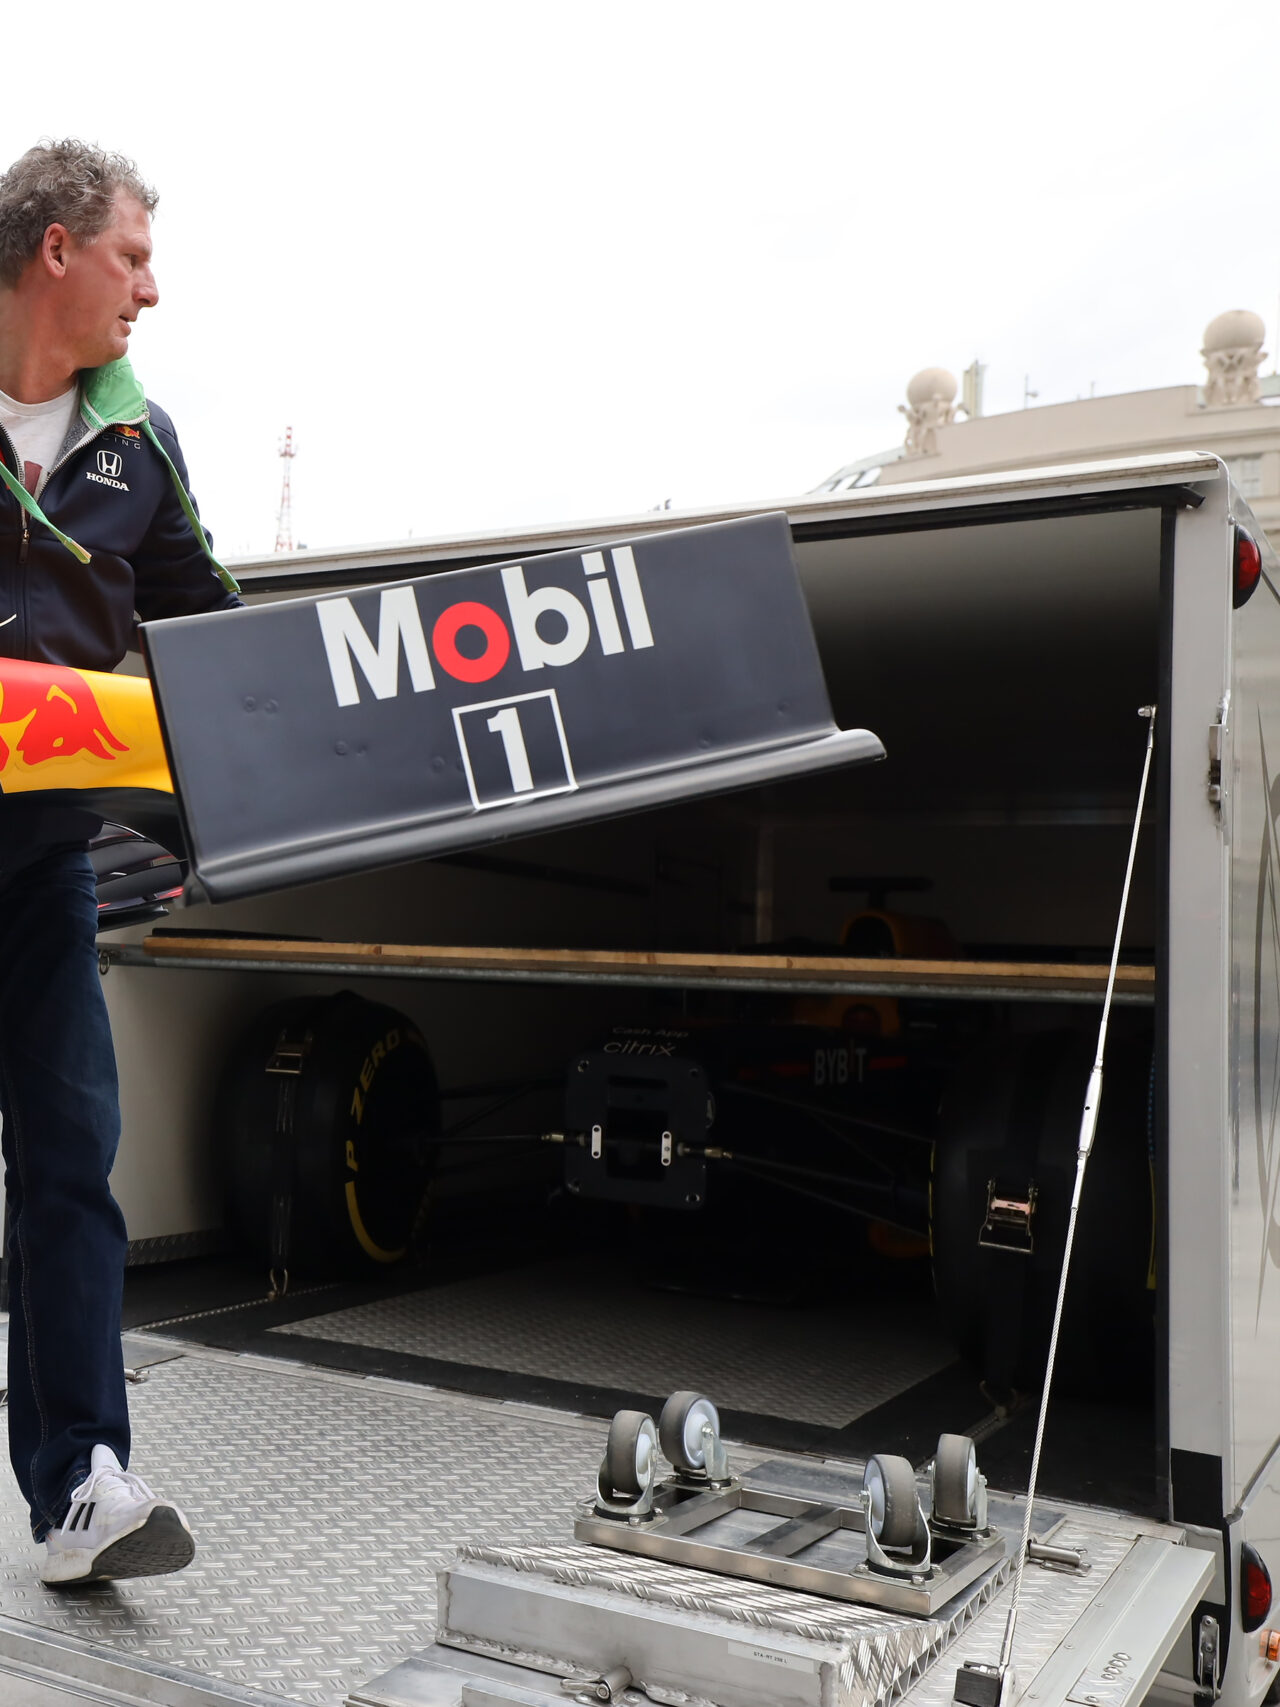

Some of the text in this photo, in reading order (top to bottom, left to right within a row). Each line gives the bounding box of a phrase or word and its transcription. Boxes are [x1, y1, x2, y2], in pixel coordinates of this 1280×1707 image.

[86, 471, 130, 492] HONDA
[315, 545, 655, 708] Mobil
[486, 706, 534, 794] 1
[603, 1035, 677, 1057] citrix
[344, 1028, 401, 1174] P ZERO
